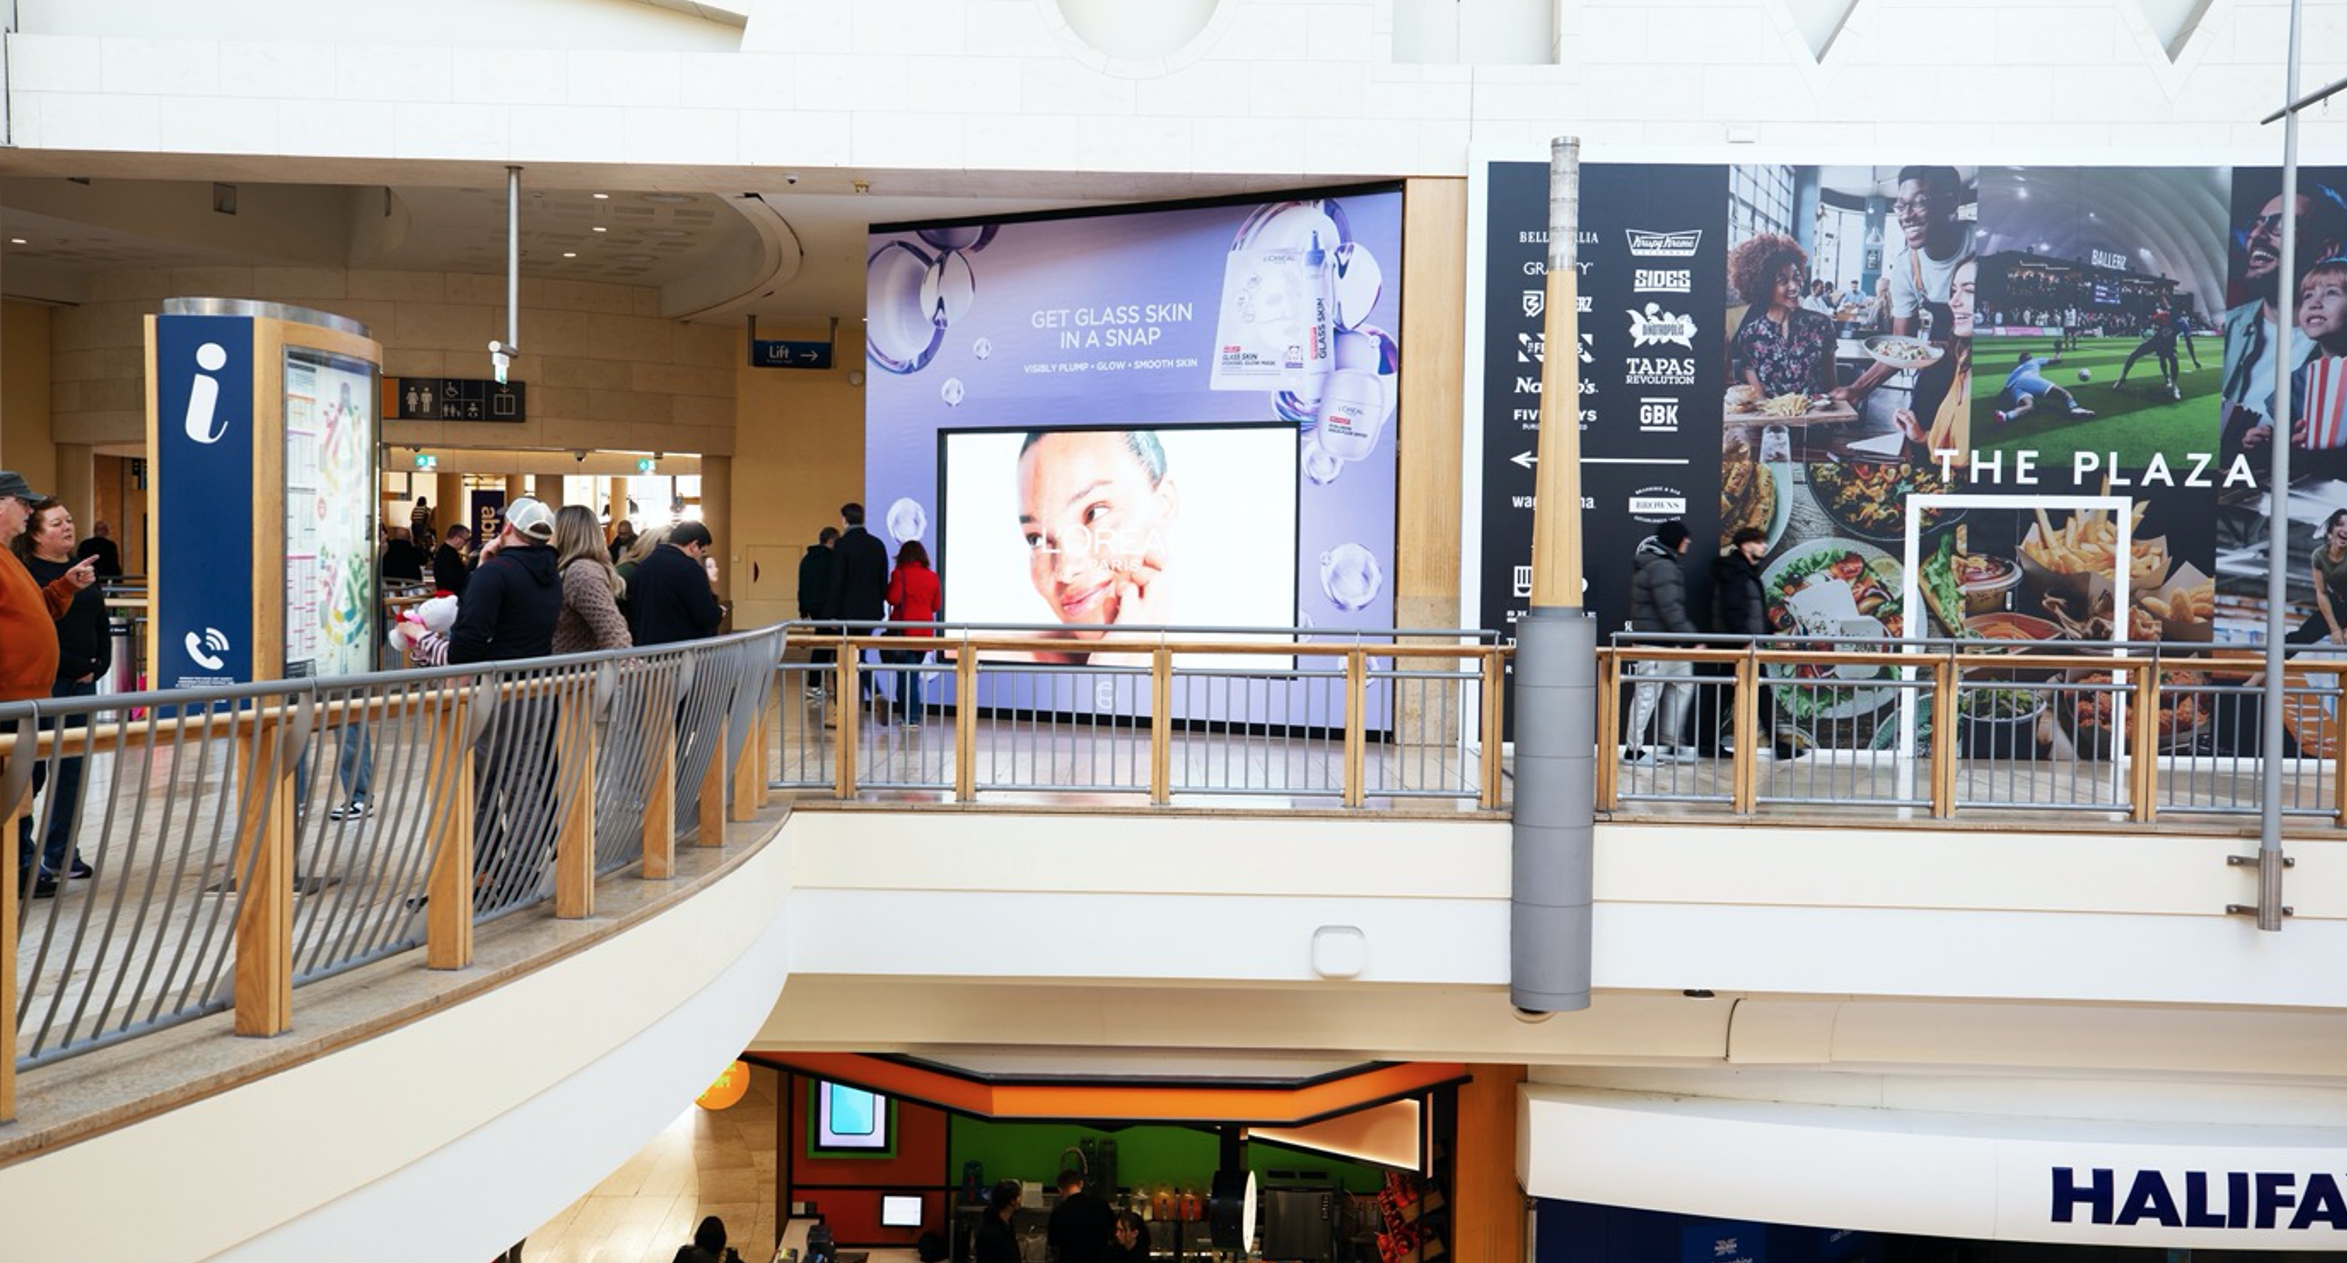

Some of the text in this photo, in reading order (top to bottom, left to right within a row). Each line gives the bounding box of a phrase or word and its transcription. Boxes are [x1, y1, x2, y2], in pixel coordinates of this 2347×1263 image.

[1519, 231, 1550, 243] BELL
[1635, 269, 1691, 287] SIDES
[1032, 302, 1193, 328] GET GLASS SKIN
[1060, 327, 1161, 349] IN A SNAP
[769, 345, 790, 359] Lift
[1024, 358, 1198, 374] VISIBLY PLUMP GLOW SMOOTH SKIN
[1626, 357, 1695, 376] TAPAS
[1514, 377, 1596, 394] Nao's
[1626, 375, 1695, 385] REVOLUTION
[1514, 409, 1541, 421] FIV
[1640, 404, 1678, 425] GBK
[1934, 448, 2257, 488] THE PLAZA
[2051, 1167, 2347, 1230] HALIFA
